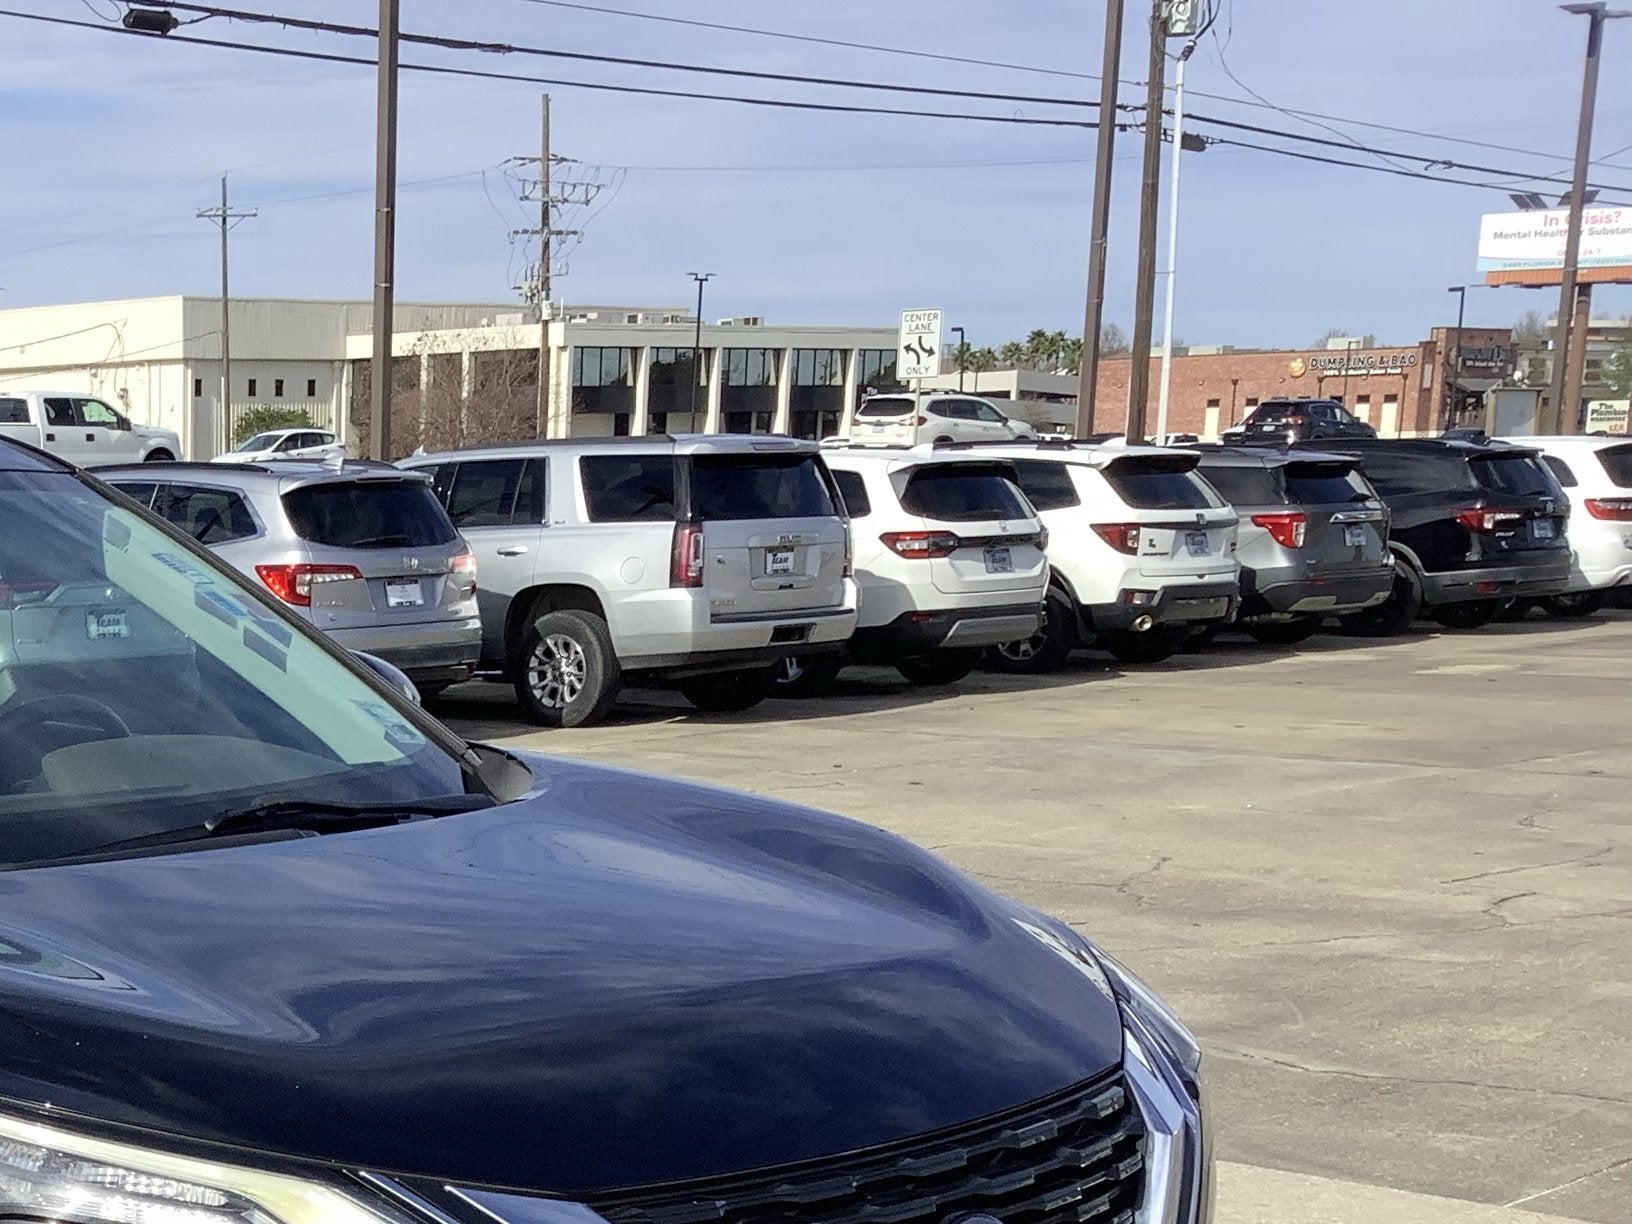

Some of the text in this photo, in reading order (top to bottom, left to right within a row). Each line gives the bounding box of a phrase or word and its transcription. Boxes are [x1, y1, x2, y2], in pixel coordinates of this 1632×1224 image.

[1544, 214, 1559, 227] In
[1493, 230, 1531, 239] Mental
[904, 312, 939, 322] CENTER
[909, 323, 932, 332] LANE
[1378, 355, 1386, 366] &
[1391, 354, 1417, 366] BAO
[906, 366, 930, 375] ONLY
